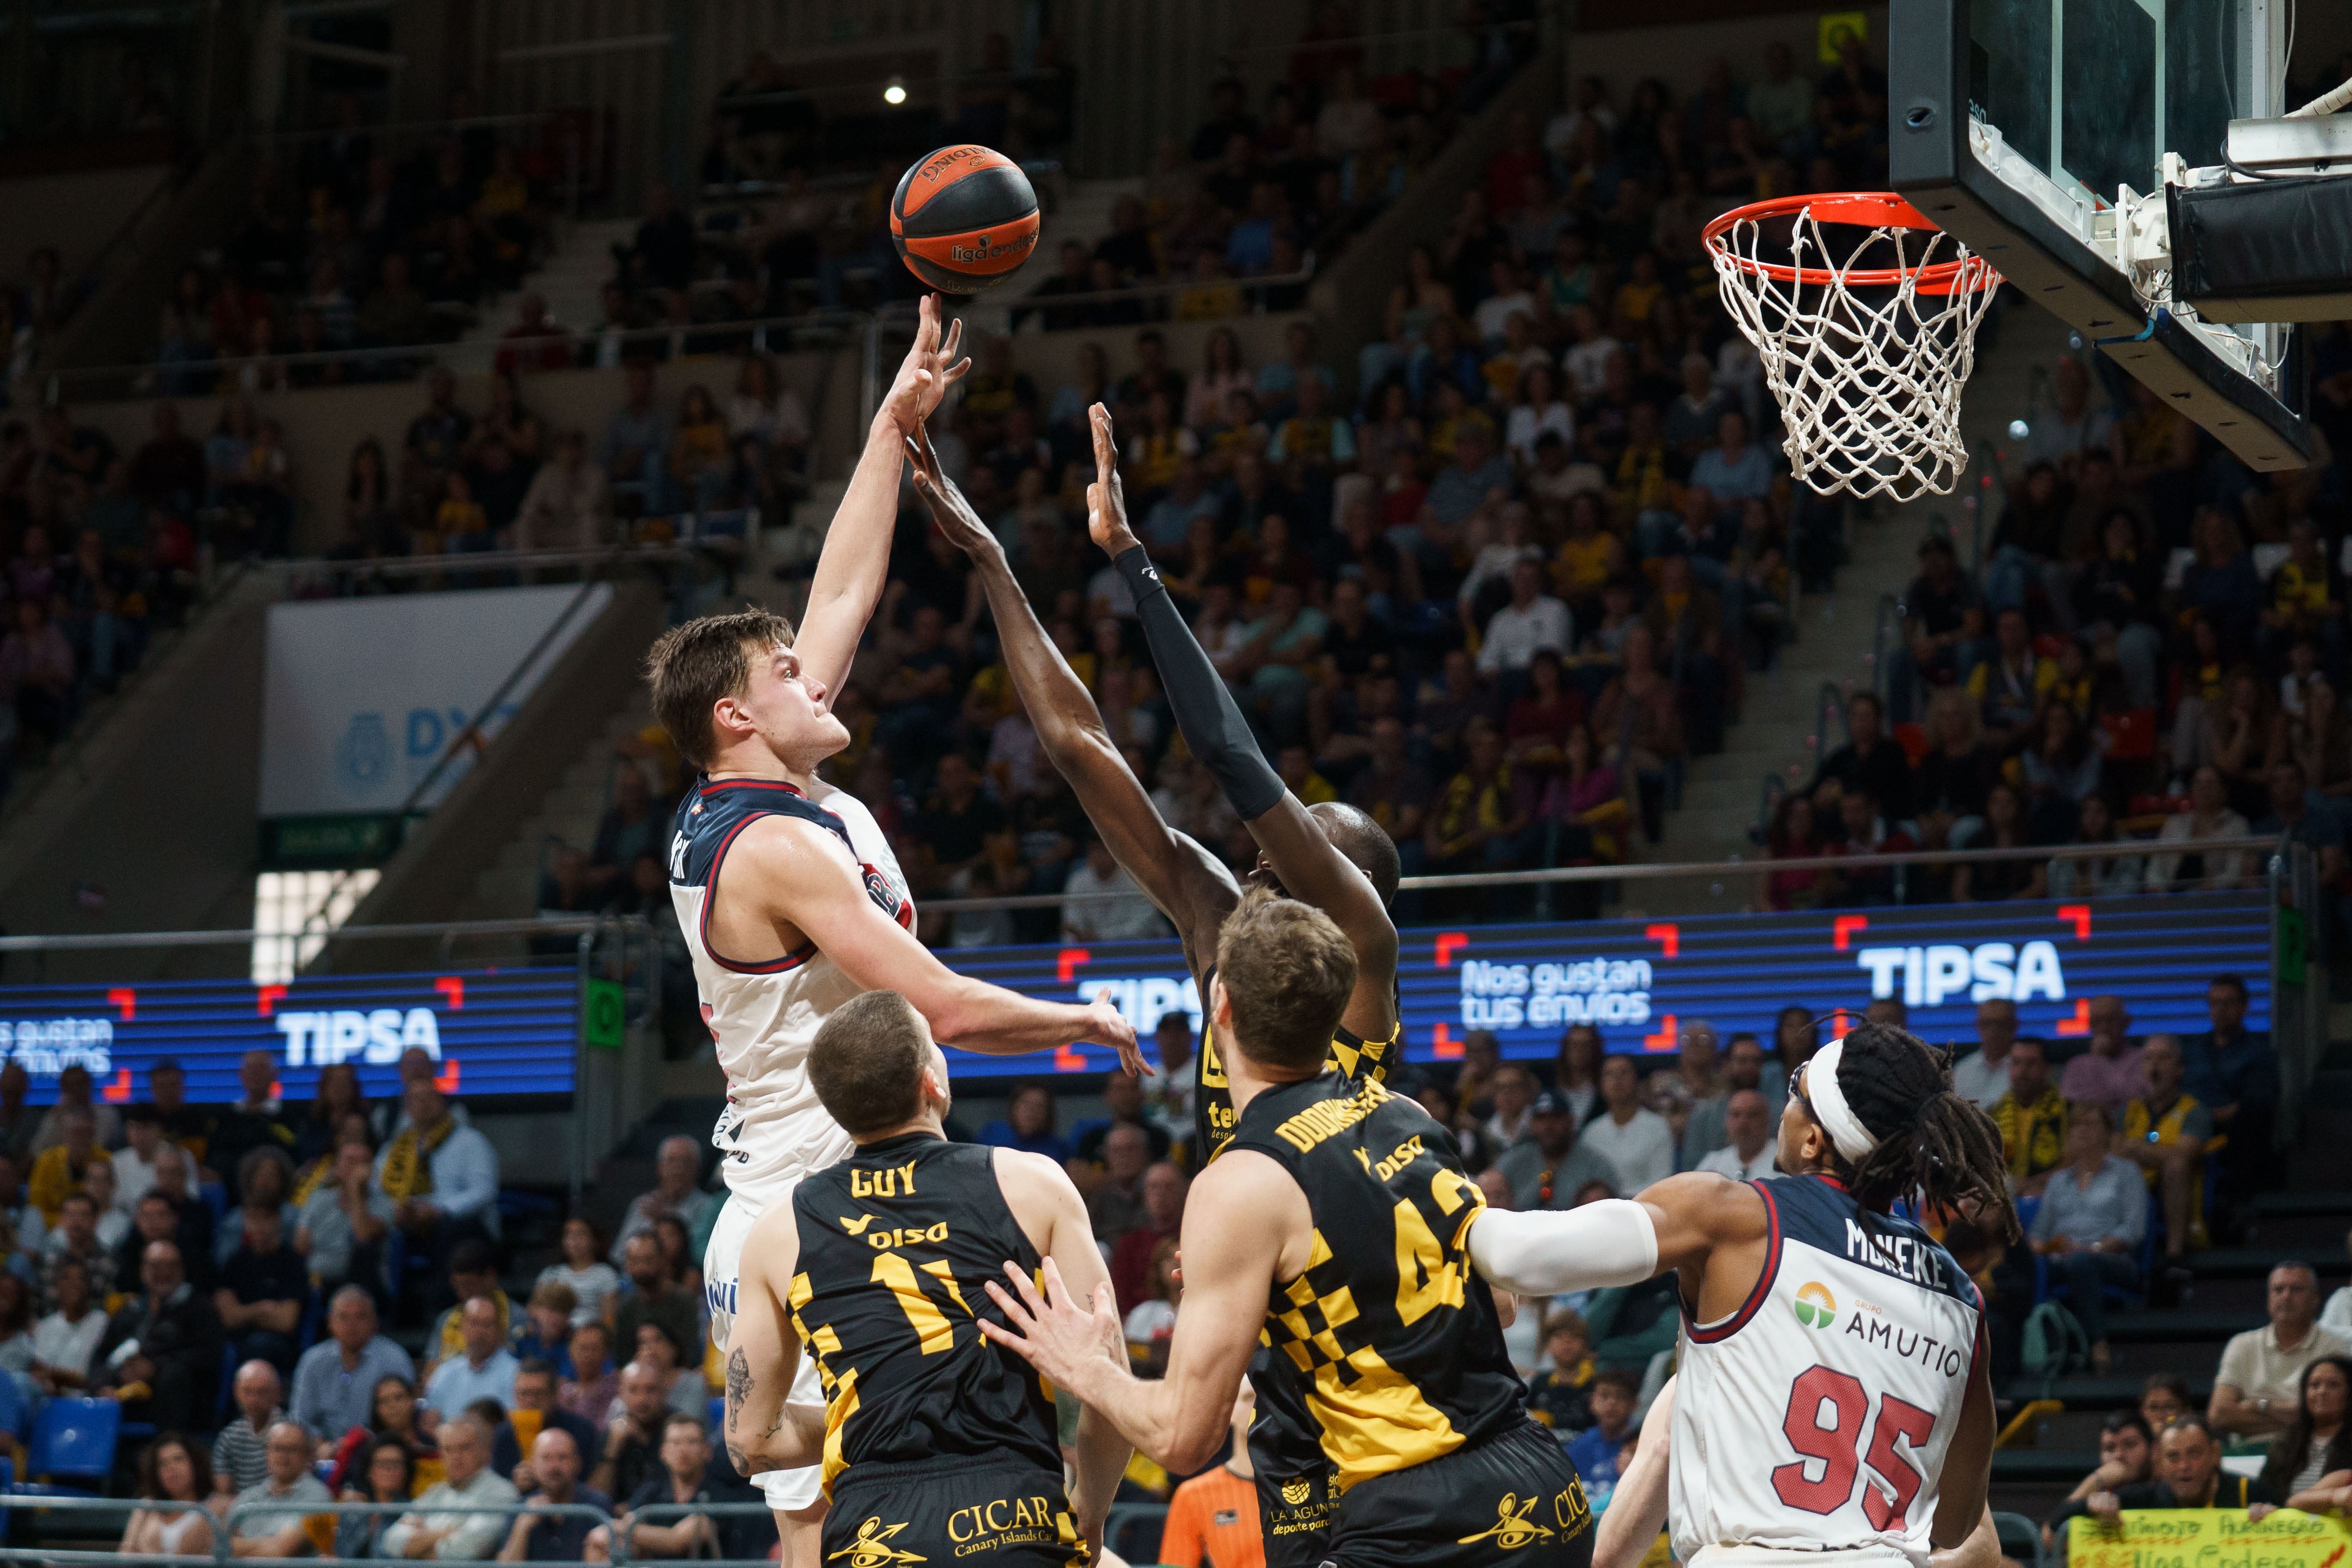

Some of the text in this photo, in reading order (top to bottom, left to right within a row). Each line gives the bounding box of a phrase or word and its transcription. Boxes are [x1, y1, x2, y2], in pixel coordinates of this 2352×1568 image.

[920, 147, 988, 183] ALDING
[952, 245, 988, 263] liga
[1461, 957, 1653, 996] Nos gustan
[1858, 941, 2066, 1008] TIPSA
[1460, 995, 1525, 1030] tus
[276, 1007, 442, 1066] TIPSA
[1374, 1135, 1425, 1182] DISA
[851, 1159, 917, 1198] GUY
[868, 1221, 948, 1250] DISA
[1855, 1299, 1882, 1315] GRUPO
[1845, 1310, 1961, 1378] AMUTIO
[1770, 1362, 1937, 1533] 95
[947, 1496, 1054, 1543] CICAR
[1273, 1522, 1308, 1536] deporte
[954, 1538, 998, 1557] Canary
[1001, 1529, 1037, 1544] Islands
